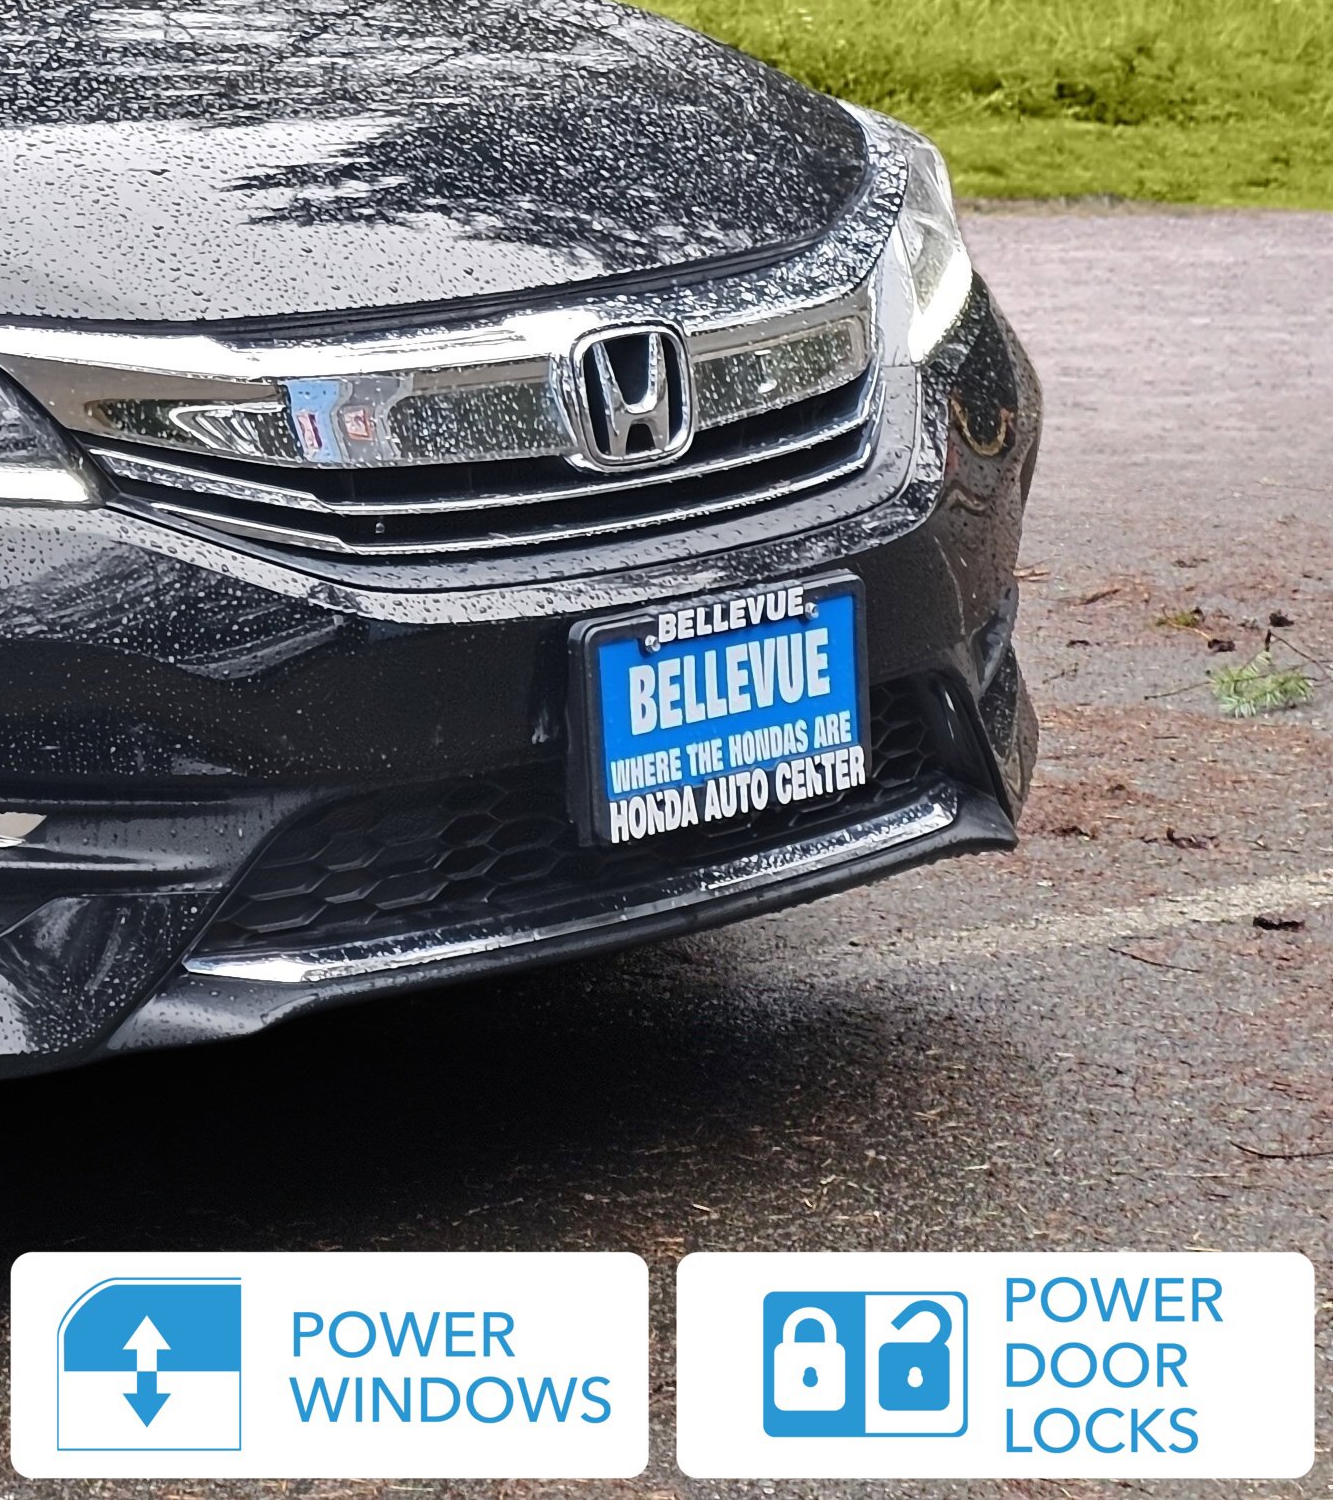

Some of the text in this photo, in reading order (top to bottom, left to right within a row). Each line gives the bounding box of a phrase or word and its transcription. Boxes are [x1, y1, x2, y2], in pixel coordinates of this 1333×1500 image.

[658, 587, 805, 643] BELLEVUE
[628, 627, 831, 736] BELLEVUE
[609, 745, 866, 844] HONDA AUTO CENTER
[610, 710, 852, 794] WHERE THE HONDAS ARE
